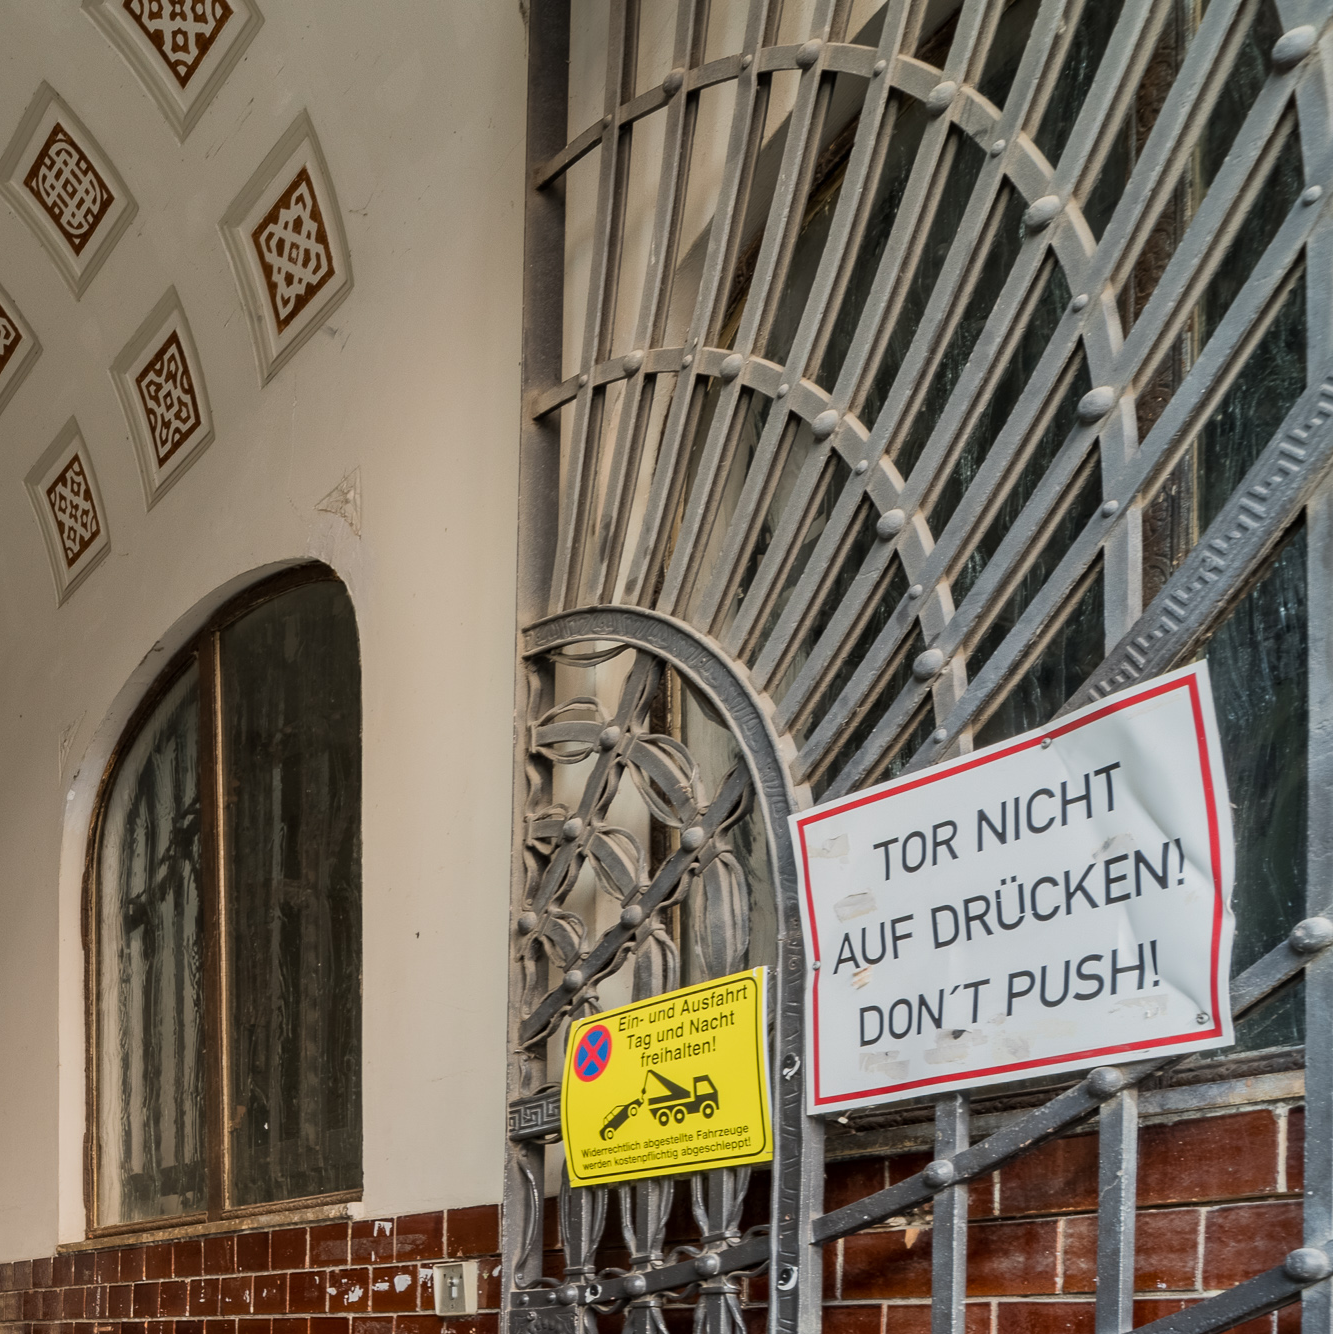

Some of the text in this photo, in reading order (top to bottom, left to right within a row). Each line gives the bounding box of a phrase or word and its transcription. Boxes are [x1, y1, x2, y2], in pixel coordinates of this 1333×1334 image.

[873, 761, 1121, 881] TOR NICHT
[833, 838, 1185, 975] AUF DRÜCKEN!
[1006, 939, 1161, 1017] PUSH!
[618, 984, 748, 1032] Ein- und Ausfahrt
[627, 1010, 735, 1050] Tag und Nacht
[640, 1036, 717, 1067] freihalten!
[581, 1124, 749, 1158] Widerrechtlich abgestellte Fahrzeuge
[583, 1137, 751, 1171] werden kostenpflichtig abgeschleppt!
